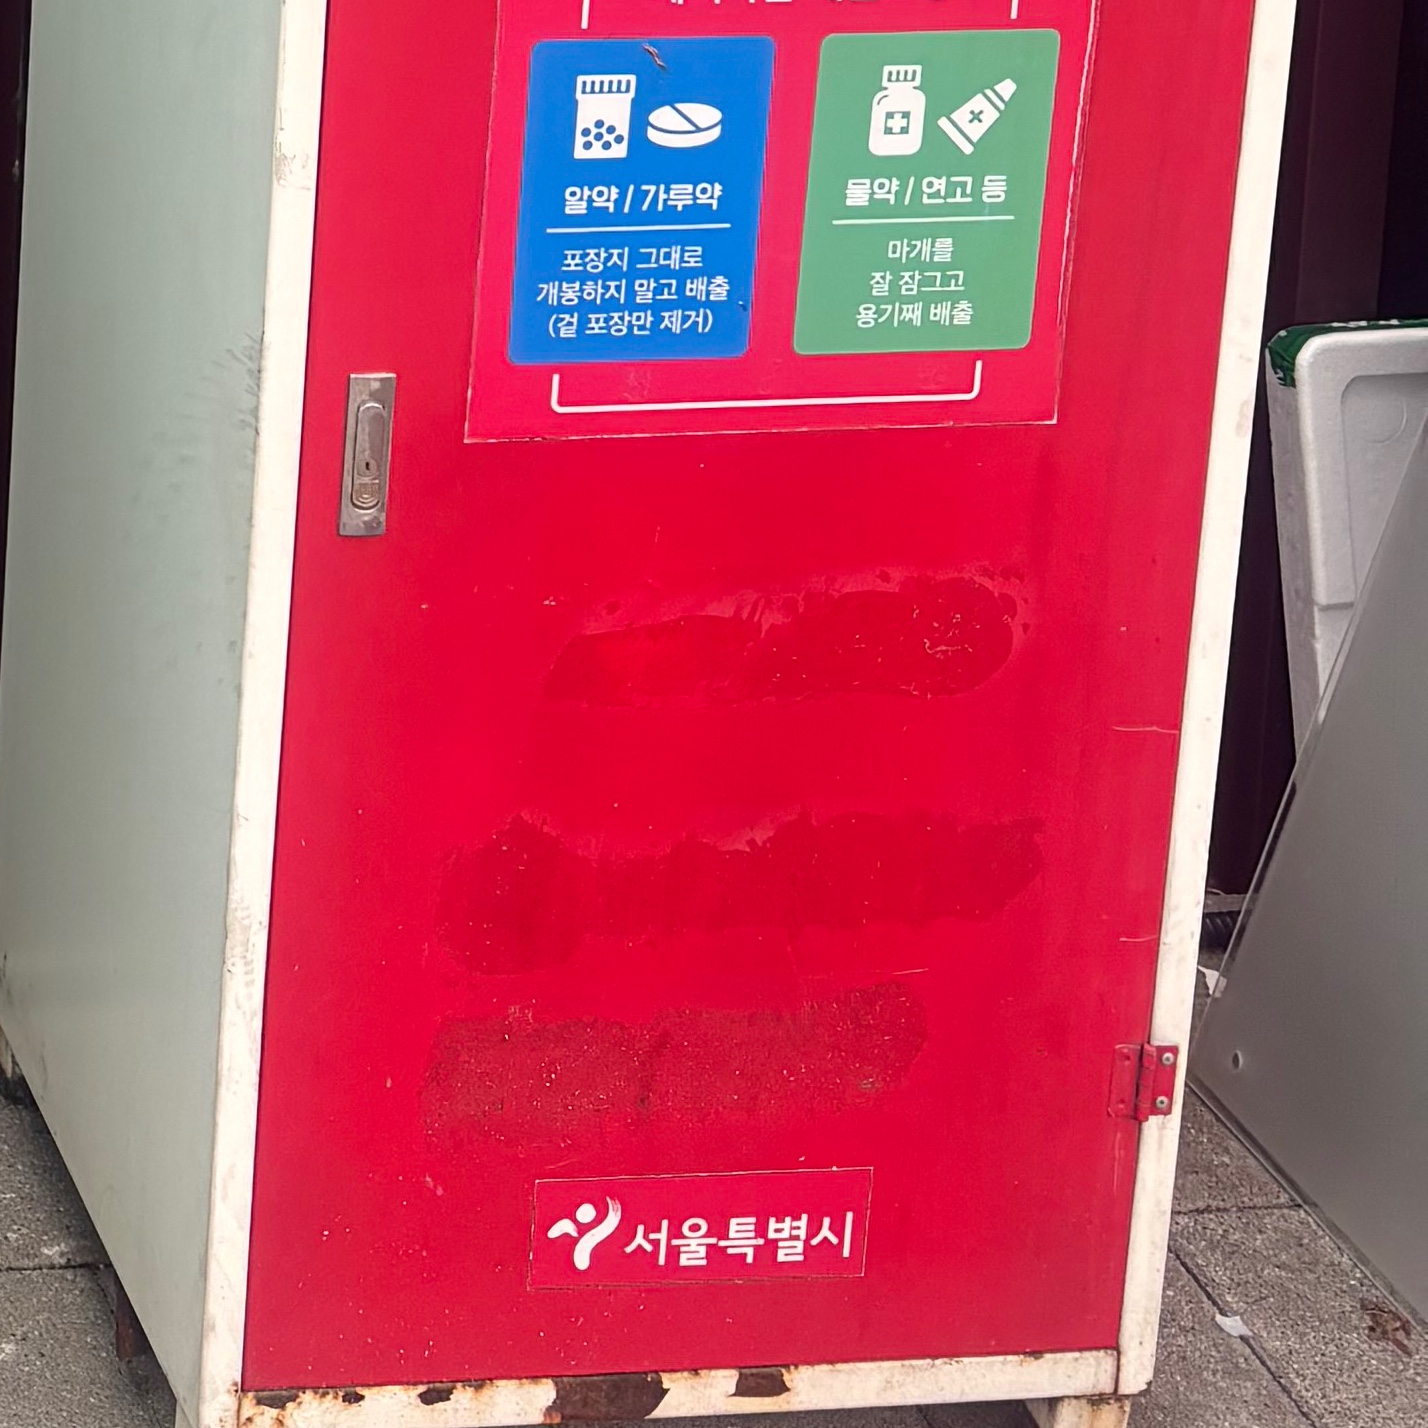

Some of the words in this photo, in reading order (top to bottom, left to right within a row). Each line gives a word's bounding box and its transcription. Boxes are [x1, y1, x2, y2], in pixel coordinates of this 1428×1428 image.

[564, 185, 618, 214] 알약
[641, 183, 723, 212] 가루약
[845, 178, 899, 207] 물약
[921, 176, 973, 204] 연고
[981, 174, 1007, 202] 등
[562, 248, 630, 272] 포장지
[640, 245, 704, 268] 그대로
[888, 237, 954, 260] 마개를
[537, 280, 626, 306] 개봉하지
[634, 278, 677, 302] 말고
[685, 276, 730, 301] 배출
[869, 271, 892, 295] 잘
[900, 268, 965, 294] 잠그고
[548, 312, 577, 338] (겉
[585, 309, 653, 334] 포장만
[660, 308, 713, 333] 제거)
[855, 302, 921, 327] 용기째
[929, 300, 973, 325] 배출
[624, 1211, 853, 1266] 서울특별시
